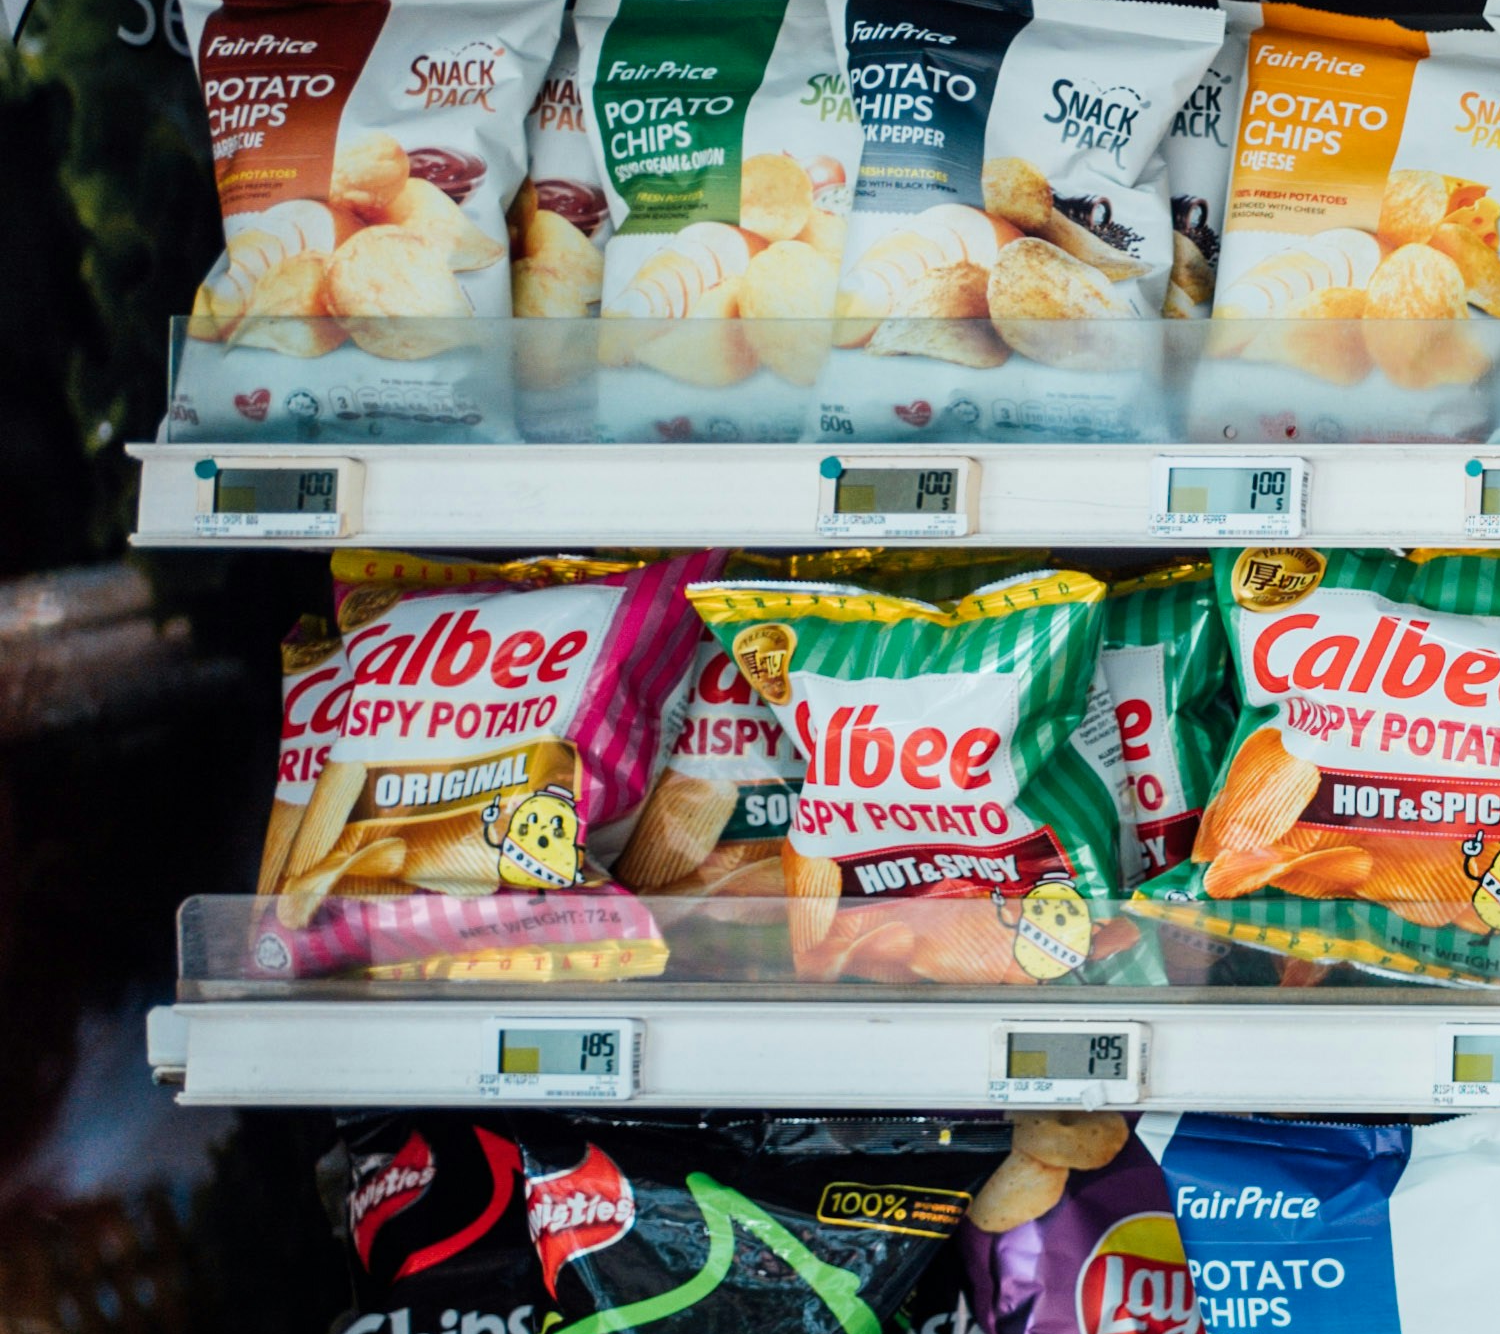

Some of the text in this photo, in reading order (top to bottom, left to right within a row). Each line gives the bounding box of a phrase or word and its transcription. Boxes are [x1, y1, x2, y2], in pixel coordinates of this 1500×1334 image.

[207, 35, 318, 59] FairPrice
[407, 53, 495, 96] SNACK
[607, 60, 719, 83] FairPrice
[203, 75, 334, 101] POTATO
[424, 87, 497, 112] PACK
[1247, 90, 1388, 133] POTATO
[610, 120, 692, 157] CHIPS
[1240, 148, 1296, 174] CHEESE
[376, 753, 529, 808] ORIGINAL
[830, 1192, 906, 1220] 100%
[1186, 1259, 1345, 1291] POTATO
